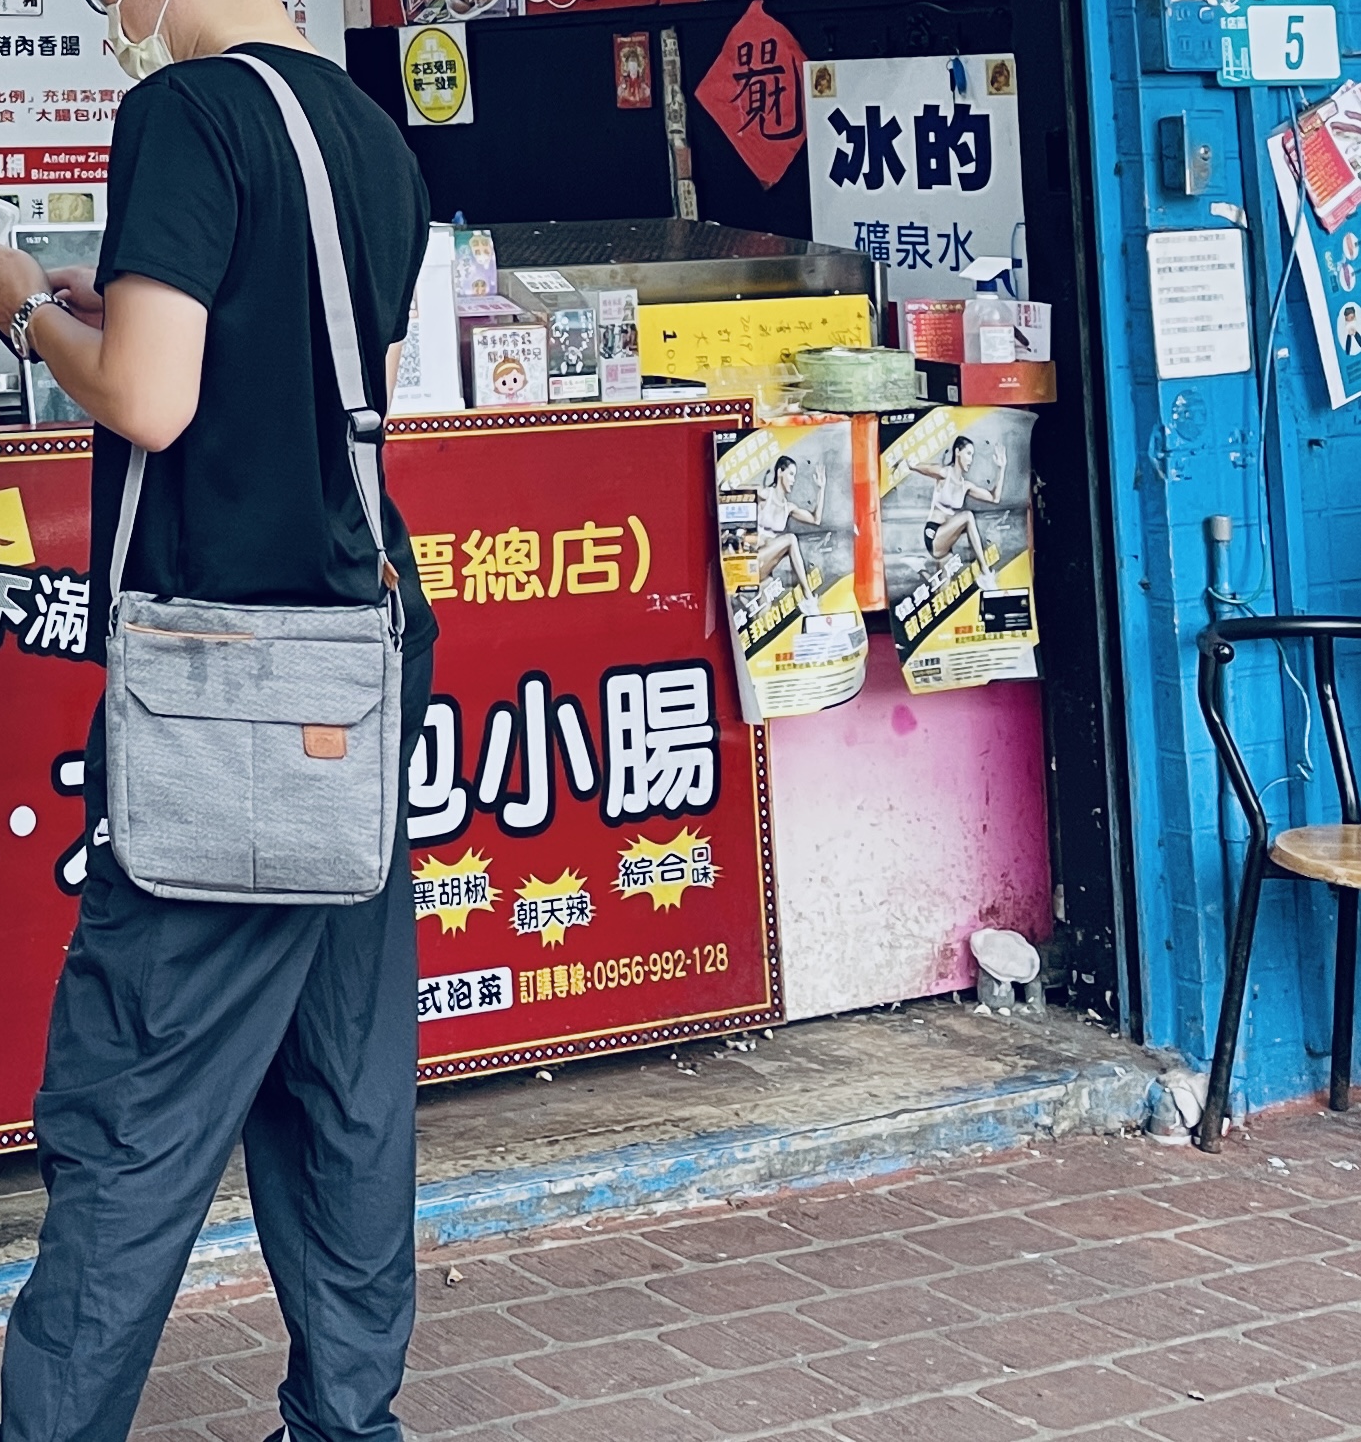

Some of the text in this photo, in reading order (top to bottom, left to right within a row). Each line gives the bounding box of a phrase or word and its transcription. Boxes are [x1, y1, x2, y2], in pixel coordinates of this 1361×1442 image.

[1286, 16, 1304, 70] 5
[43, 153, 86, 164] Andrew
[827, 104, 992, 191] 冰的
[31, 167, 108, 180] Bizarre Foods
[414, 873, 489, 911] 黑胡椒
[517, 893, 590, 929] 朝天辣
